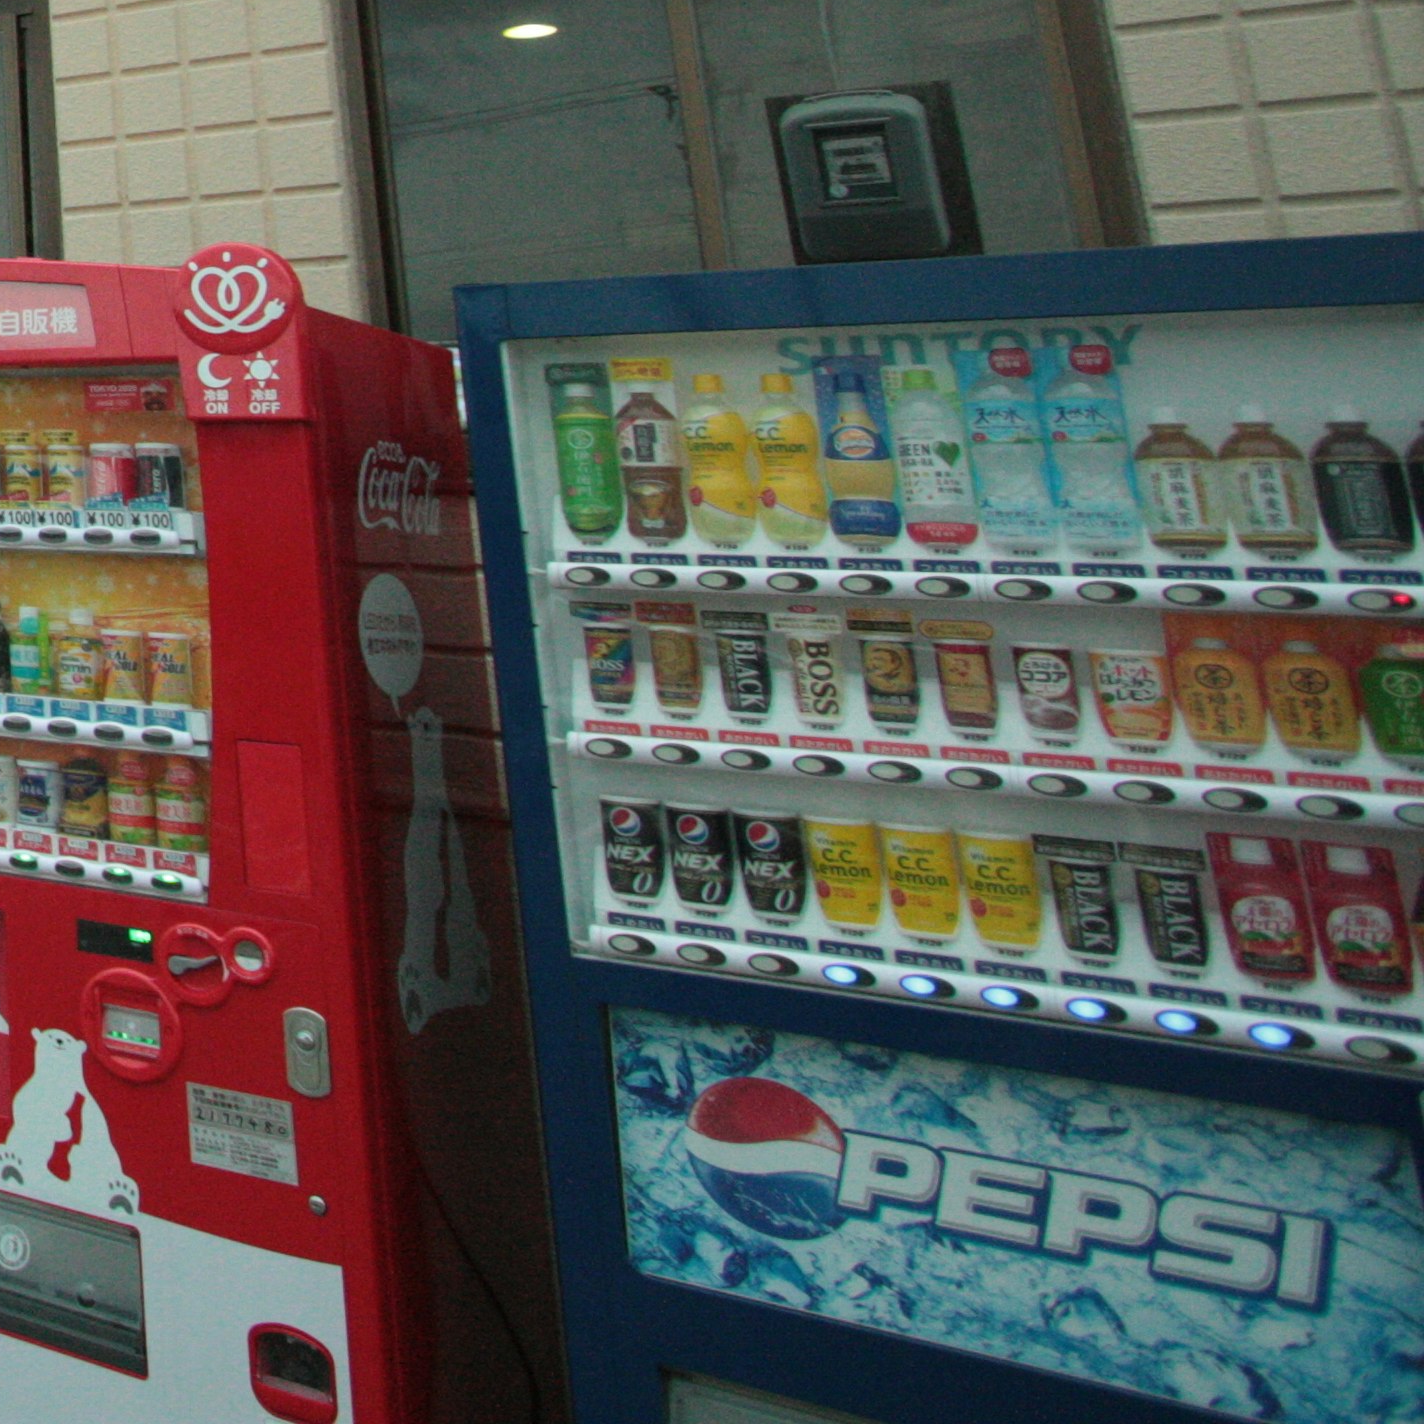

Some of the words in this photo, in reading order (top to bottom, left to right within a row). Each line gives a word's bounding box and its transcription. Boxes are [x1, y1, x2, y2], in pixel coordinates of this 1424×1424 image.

[203, 389, 229, 402] 冷却
[251, 389, 278, 401] 冷却
[205, 402, 229, 414] ON
[248, 402, 281, 414] OFF
[357, 446, 441, 537] Coca-Cola
[37, 511, 73, 525] ¥100
[87, 512, 124, 527] ¥100
[131, 514, 170, 528] ¥100
[731, 639, 766, 709] BLACK
[804, 640, 840, 716] BOSS
[1020, 669, 1068, 683] ココア
[606, 843, 655, 863] NEX
[674, 851, 726, 872] NEX
[744, 859, 796, 879] NEX
[1072, 869, 1114, 950] BLACK
[1160, 878, 1203, 962] BLACK
[836, 1130, 1336, 1314] PEPSI
